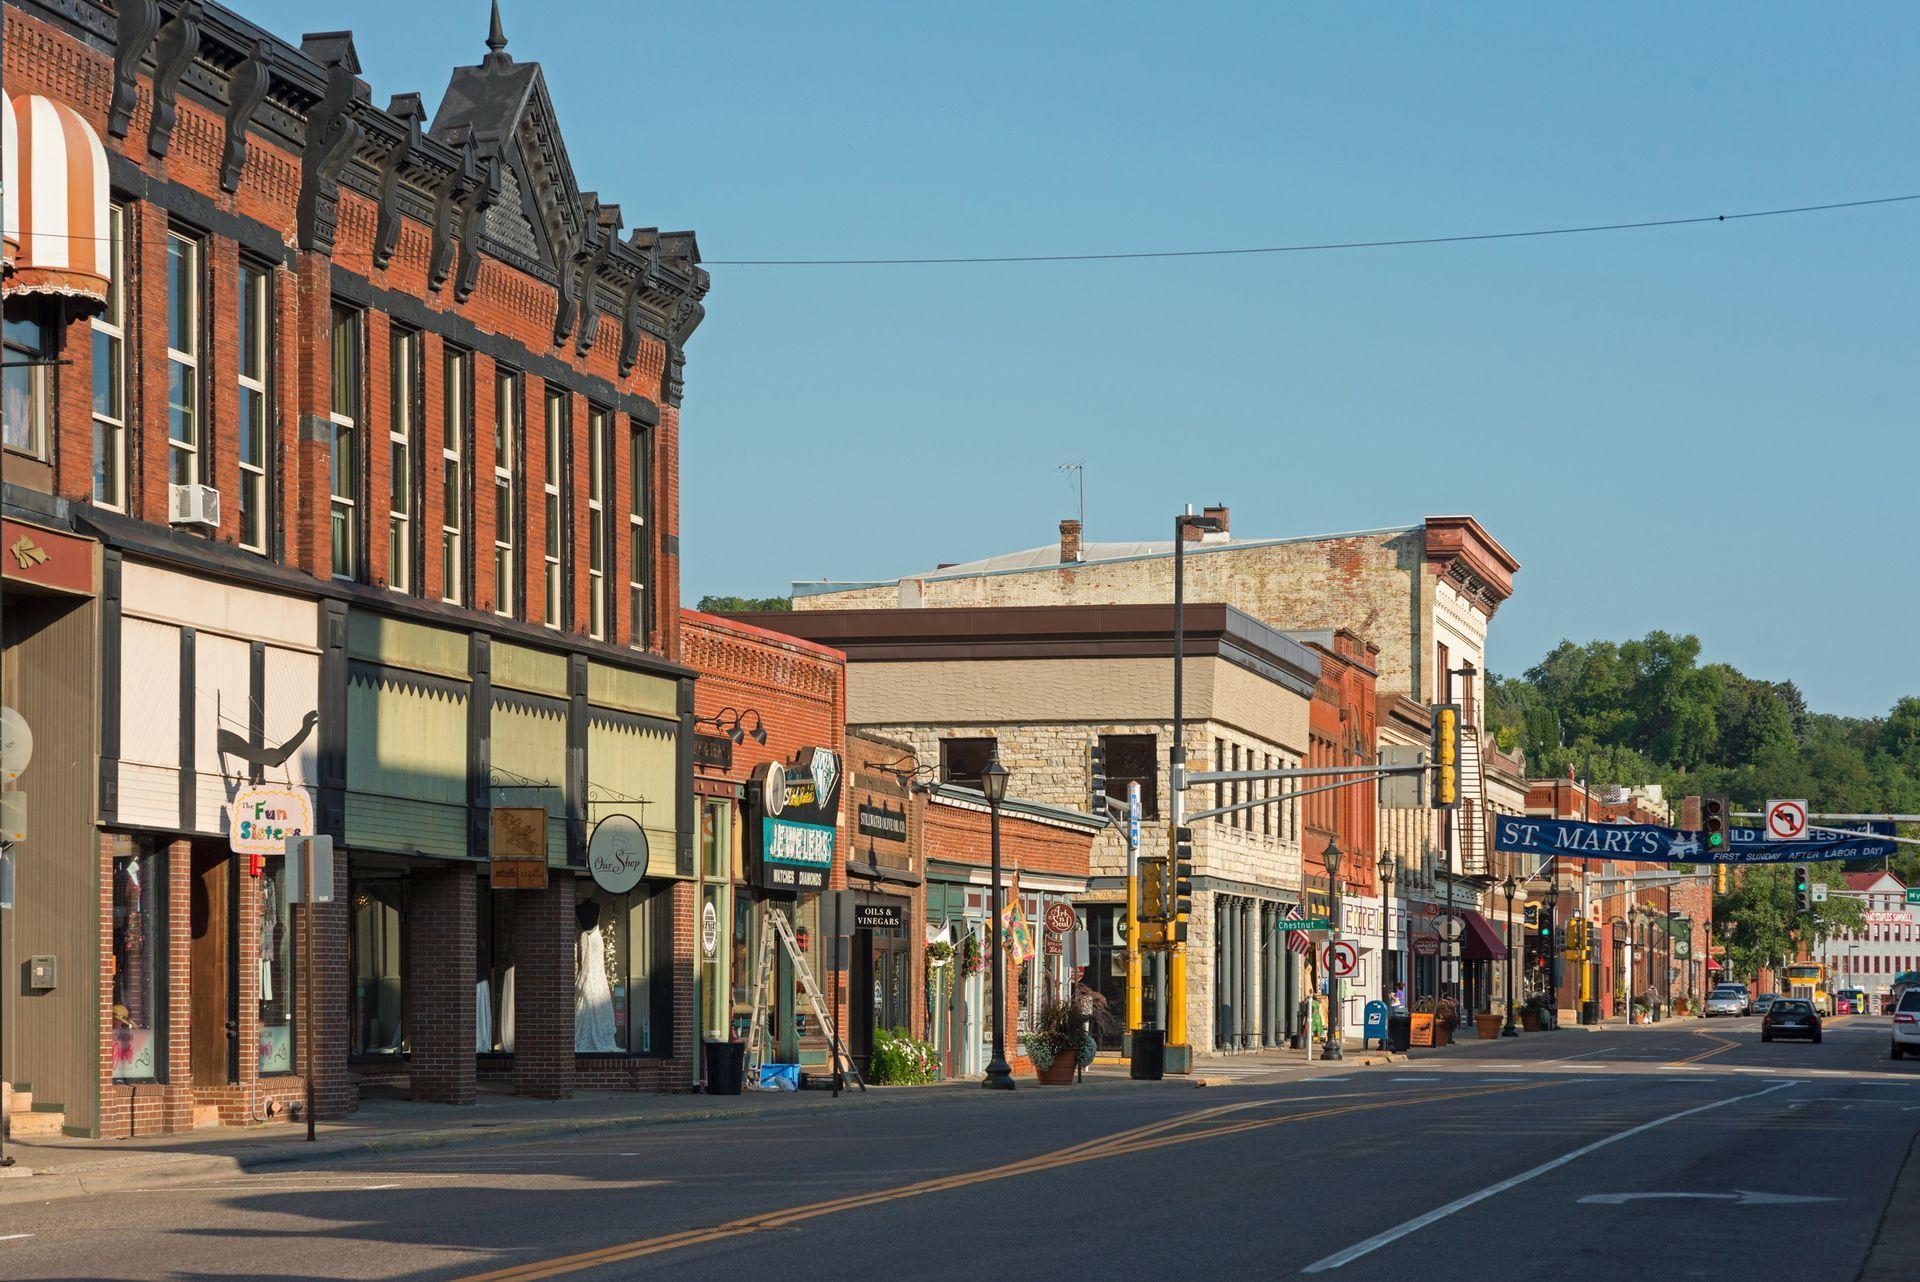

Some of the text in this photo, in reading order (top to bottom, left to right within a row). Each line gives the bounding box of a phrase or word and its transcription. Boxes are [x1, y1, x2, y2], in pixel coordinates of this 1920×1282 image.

[255, 800, 287, 820] Fun
[1502, 822, 1660, 854] ST. MARY'S
[1730, 829, 1755, 842] ILD
[769, 824, 832, 863] JEWELERS
[1713, 847, 1884, 861] FIRST SUNDAY AFTER LABOR DAY!
[594, 849, 640, 875] Our Shop
[773, 869, 822, 886] WATCHES DIAMONDS
[864, 908, 892, 916] OILS &
[1051, 906, 1067, 917] Art
[857, 917, 900, 926] VINEGARS
[1278, 921, 1314, 929] Chestnut
